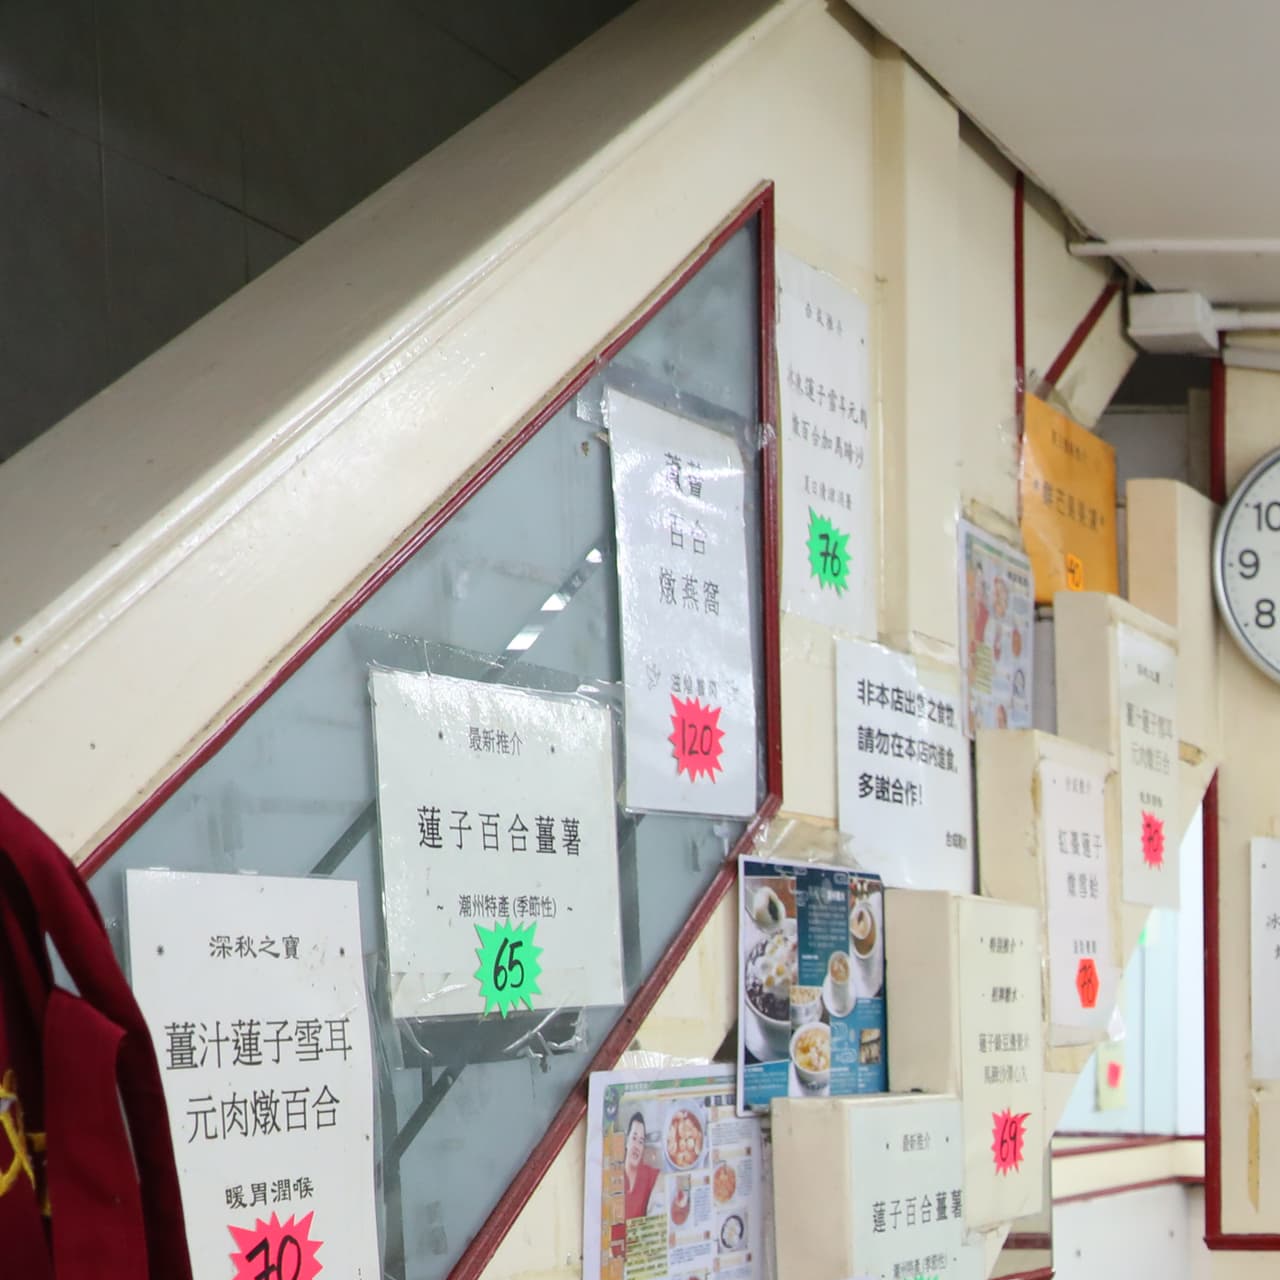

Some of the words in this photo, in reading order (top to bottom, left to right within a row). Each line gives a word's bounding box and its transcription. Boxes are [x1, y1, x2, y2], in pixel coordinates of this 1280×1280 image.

[818, 533, 842, 578] 76
[1238, 549, 1260, 579] 9
[1255, 598, 1276, 629] 8
[468, 726, 524, 756] 最新推介
[680, 717, 714, 757] 120
[416, 805, 582, 857] 蓮子百合薑薯
[209, 935, 301, 960] 深秋之寶
[492, 937, 525, 990] 65
[164, 1017, 353, 1072] 薑汁蓮子雪耳
[186, 1085, 341, 1145] 元肉燉百合
[999, 1119, 1019, 1163] 69
